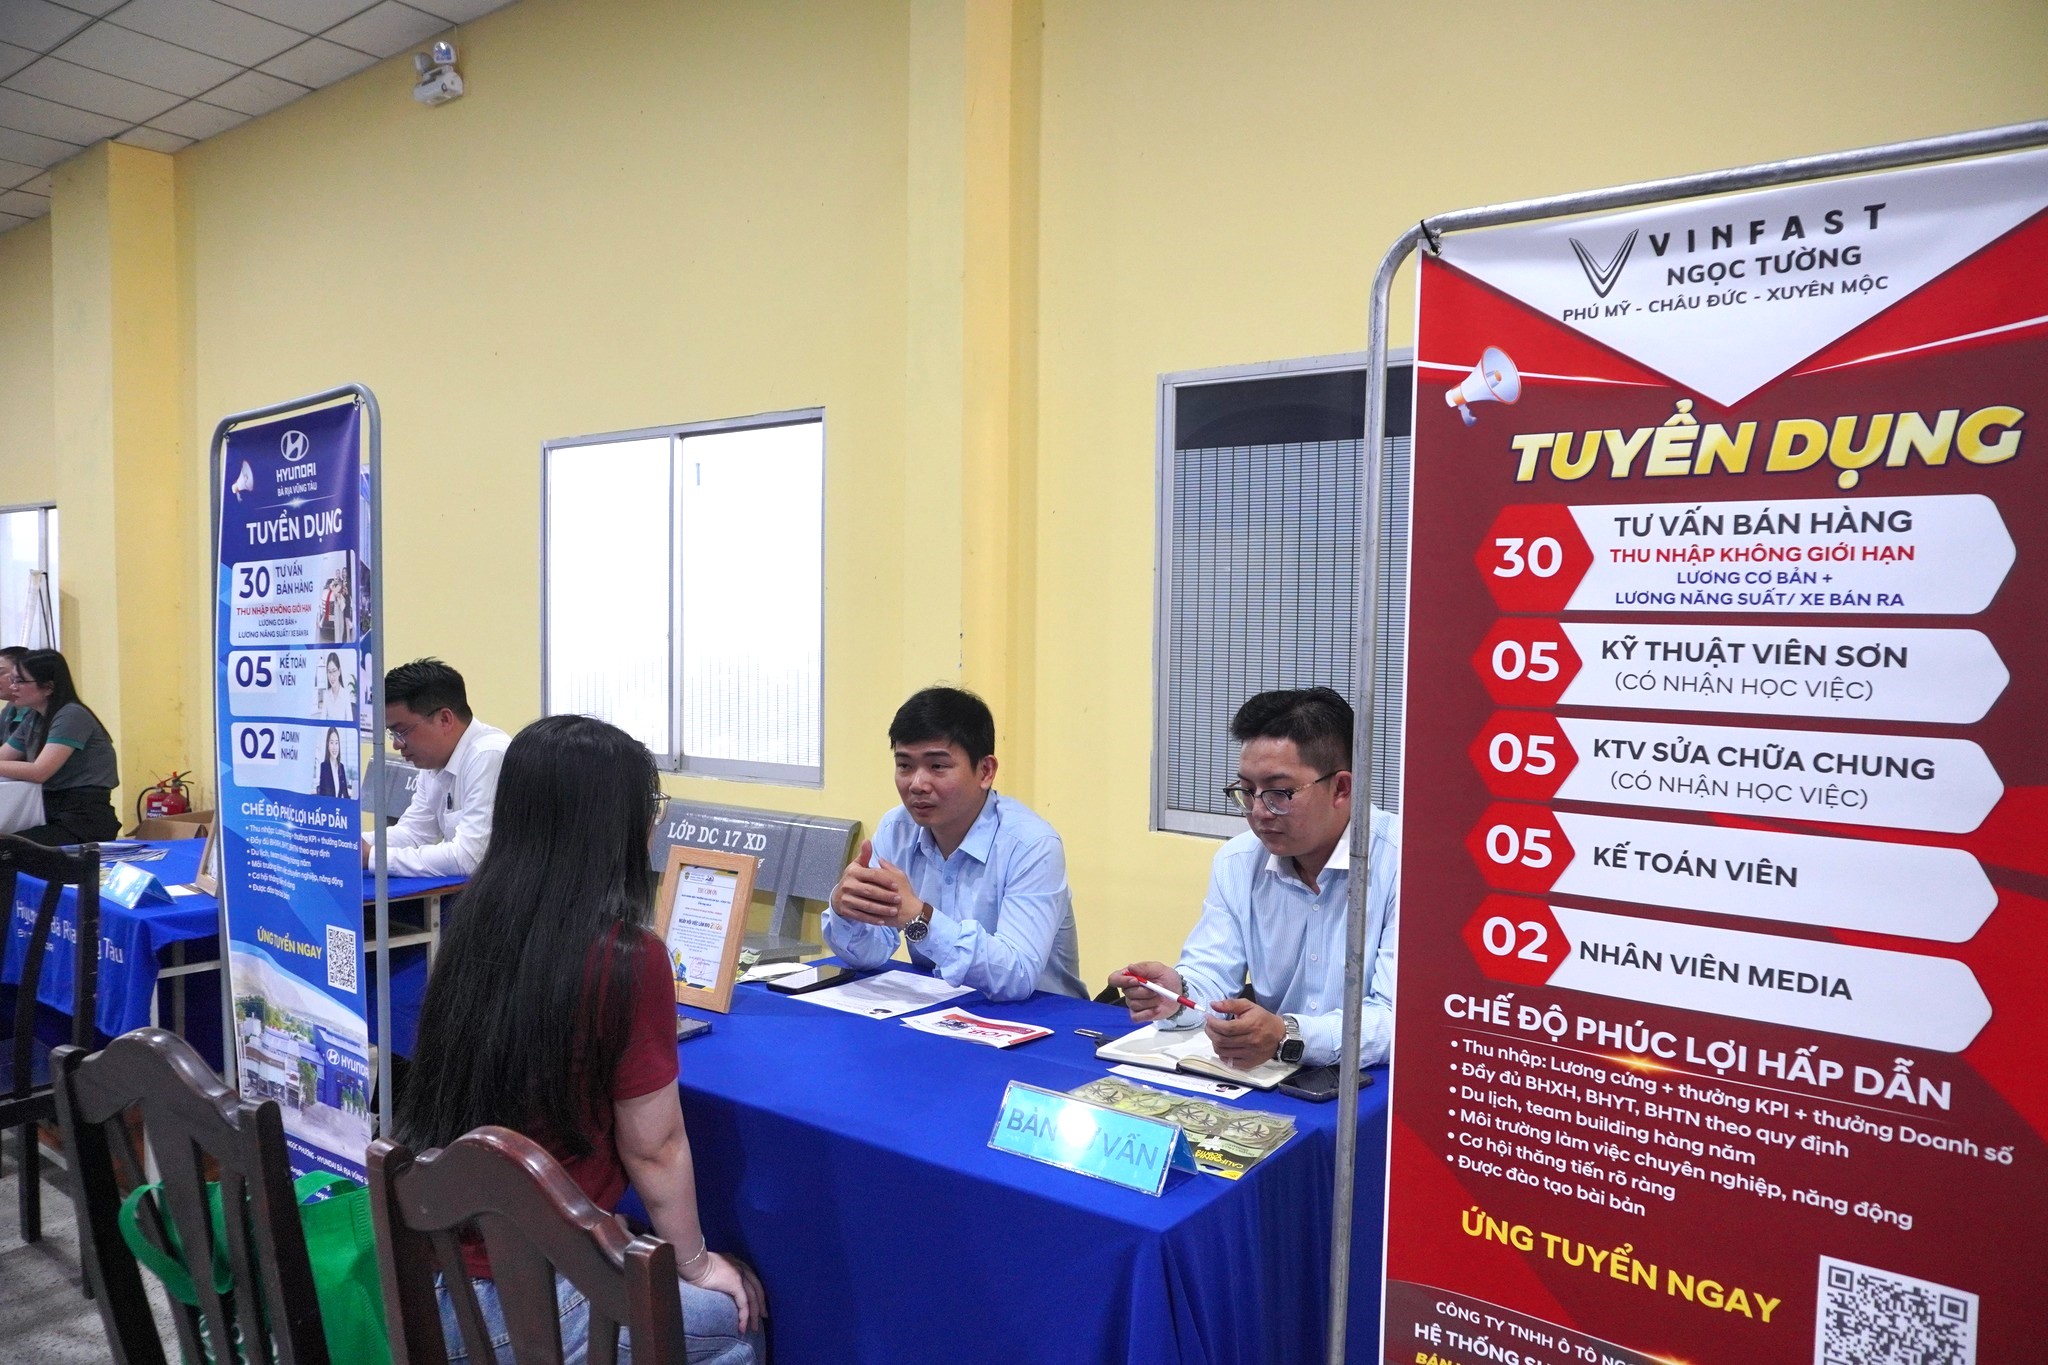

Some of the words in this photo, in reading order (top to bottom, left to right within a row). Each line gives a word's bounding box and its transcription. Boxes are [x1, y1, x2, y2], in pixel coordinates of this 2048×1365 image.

[1649, 203, 1886, 257] VINFAST
[1667, 259, 1746, 287] NGỌC
[1755, 246, 1862, 276] TƯỜNG
[1563, 303, 1599, 321] PHÚ
[1605, 300, 1631, 318] MỸ
[1648, 294, 1701, 313] CHÂU
[1707, 288, 1747, 308] ĐỨC
[1767, 280, 1834, 302] XUYÊN
[1842, 274, 1889, 295] MỘC
[1510, 399, 1757, 483] TUYỂN
[1765, 405, 2025, 491] DỤNG
[276, 463, 317, 483] HYUNDAI
[246, 509, 300, 545] TUYỂN
[304, 508, 342, 543] DỤNG
[1615, 514, 1660, 538] TƯ
[1659, 506, 1724, 536] VẤN
[1732, 509, 1804, 535] BÁN
[1810, 505, 1914, 534] HÀNG
[1493, 537, 1563, 578] 30
[1610, 549, 1652, 564] THU
[1655, 543, 1716, 565] NHẬP
[1720, 541, 1802, 562] KHÔNG
[1807, 541, 1856, 562] GIỚI
[1861, 545, 1915, 565] HẠN
[239, 565, 271, 599] 30
[1616, 590, 1677, 606] LƯƠNG
[1680, 587, 1734, 606] NĂNG
[1737, 587, 1796, 607] SUẤT/
[1800, 593, 1824, 606] XE
[1829, 589, 1871, 606] BÁN
[1875, 593, 1904, 607] RA
[1677, 570, 1740, 585] LƯƠNG
[1744, 570, 1774, 585] CƠ
[1777, 567, 1819, 585] BẢN
[235, 655, 273, 688] 05
[1492, 641, 1559, 681] 05
[1601, 637, 1640, 662] KỸ
[1644, 641, 1746, 668] THUẬT
[1752, 639, 1828, 666] VIÊN
[1834, 644, 1909, 669] SƠN
[1615, 671, 1658, 693] (CÓ
[1663, 672, 1734, 695] NHẬN
[1740, 677, 1801, 701] HỌC
[1804, 676, 1874, 702] VIỆC)
[240, 727, 276, 760] 02
[1489, 733, 1556, 776] 05
[1593, 738, 1646, 762] KTV
[1651, 736, 1711, 766] SỬA
[1717, 743, 1806, 773] CHỮA
[1809, 752, 1937, 781] CHUNG
[1611, 770, 1652, 792] (CÓ
[1658, 774, 1730, 799] NHẬN
[1736, 781, 1796, 805] HỌC
[1799, 783, 1869, 811] VIỆC)
[241, 798, 265, 817] CHẾ
[266, 801, 280, 821] ĐỘ
[280, 804, 295, 822] PHÚC
[295, 808, 307, 827] LỢI
[307, 807, 327, 827] HẤP
[328, 808, 348, 830] DẪN
[667, 818, 696, 841] LỚP
[697, 826, 720, 845] DC
[722, 830, 741, 848] 17
[745, 832, 768, 852] XD
[1486, 824, 1552, 870] 05
[1593, 842, 1632, 869] KẾ
[1634, 849, 1717, 880] TOÁN
[1724, 858, 1798, 888] VIÊN
[257, 925, 274, 946] ỨNG
[274, 931, 296, 954] TUYỂN
[296, 941, 323, 960] NGAY
[1482, 916, 1549, 962] 02
[1580, 941, 1662, 972] NHÂN
[1669, 953, 1740, 984] VIÊN
[1748, 967, 1853, 1001] MEDIA
[1444, 993, 1515, 1027] CHẾ
[1517, 1004, 1568, 1042] ĐỘ
[1577, 1016, 1677, 1059] PHÚC
[1686, 1036, 1747, 1076] LỢI
[1758, 1045, 1844, 1088] HẤP
[1854, 1057, 1951, 1111] DẪN
[1461, 1062, 1496, 1084] Đầy
[1499, 1071, 1522, 1088] đủ
[1525, 1076, 1582, 1103] BHXH,
[1585, 1089, 1641, 1117] BHYT,
[1644, 1101, 1700, 1128] BHTN
[1705, 1115, 1751, 1138] theo
[1756, 1126, 1796, 1149] quy
[1800, 1135, 1850, 1159] định
[1463, 1039, 1494, 1058] Thu
[1498, 1045, 1547, 1069] nhập:
[1551, 1057, 1606, 1084] Lương
[1610, 1072, 1657, 1095] cứng
[1678, 1083, 1751, 1113] thưởng
[1755, 1098, 1789, 1119] KPI
[1813, 1109, 1894, 1142] thưởng
[1899, 1126, 1979, 1158] Doanh
[1984, 1146, 2015, 1166] số
[1461, 1086, 1485, 1104] Du
[1488, 1092, 1522, 1114] lịch,
[1526, 1101, 1572, 1124] team
[1576, 1113, 1650, 1145] building
[1654, 1131, 1704, 1157] hàng
[1708, 1142, 1756, 1166] năm
[1102, 1132, 1160, 1171] VẤN
[1459, 1132, 1483, 1149] Cơ
[1487, 1138, 1512, 1157] hội
[1516, 1146, 1567, 1172] thăng
[1571, 1159, 1604, 1181] tiến
[1608, 1170, 1628, 1187] rõ
[1631, 1175, 1676, 1202] ràng
[1460, 1109, 1491, 1128] Môi
[1495, 1117, 1552, 1145] trường
[1555, 1132, 1589, 1151] làm
[1593, 1141, 1630, 1163] việc
[1634, 1154, 1705, 1182] chuyên
[1710, 1169, 1787, 1201] nghiệp,
[1792, 1188, 1849, 1216] năng
[1853, 1202, 1913, 1231] động
[1457, 1155, 1502, 1179] Được
[1506, 1167, 1540, 1187] đào
[1543, 1177, 1573, 1197] tạo
[1577, 1186, 1606, 1206] bài
[1609, 1196, 1646, 1217] bản
[1462, 1205, 1534, 1252] ỨNG
[1540, 1231, 1658, 1291] TUYỂN
[1668, 1269, 1781, 1324] NGAY
[1414, 1322, 1442, 1346] HỆ
[1446, 1330, 1519, 1365] THỐNG
[1436, 1301, 1480, 1324] CÔNG
[1484, 1315, 1505, 1331] TY
[1508, 1323, 1553, 1349] TNHH
[1558, 1338, 1570, 1354] Ô
[1574, 1344, 1597, 1363] TÔ
